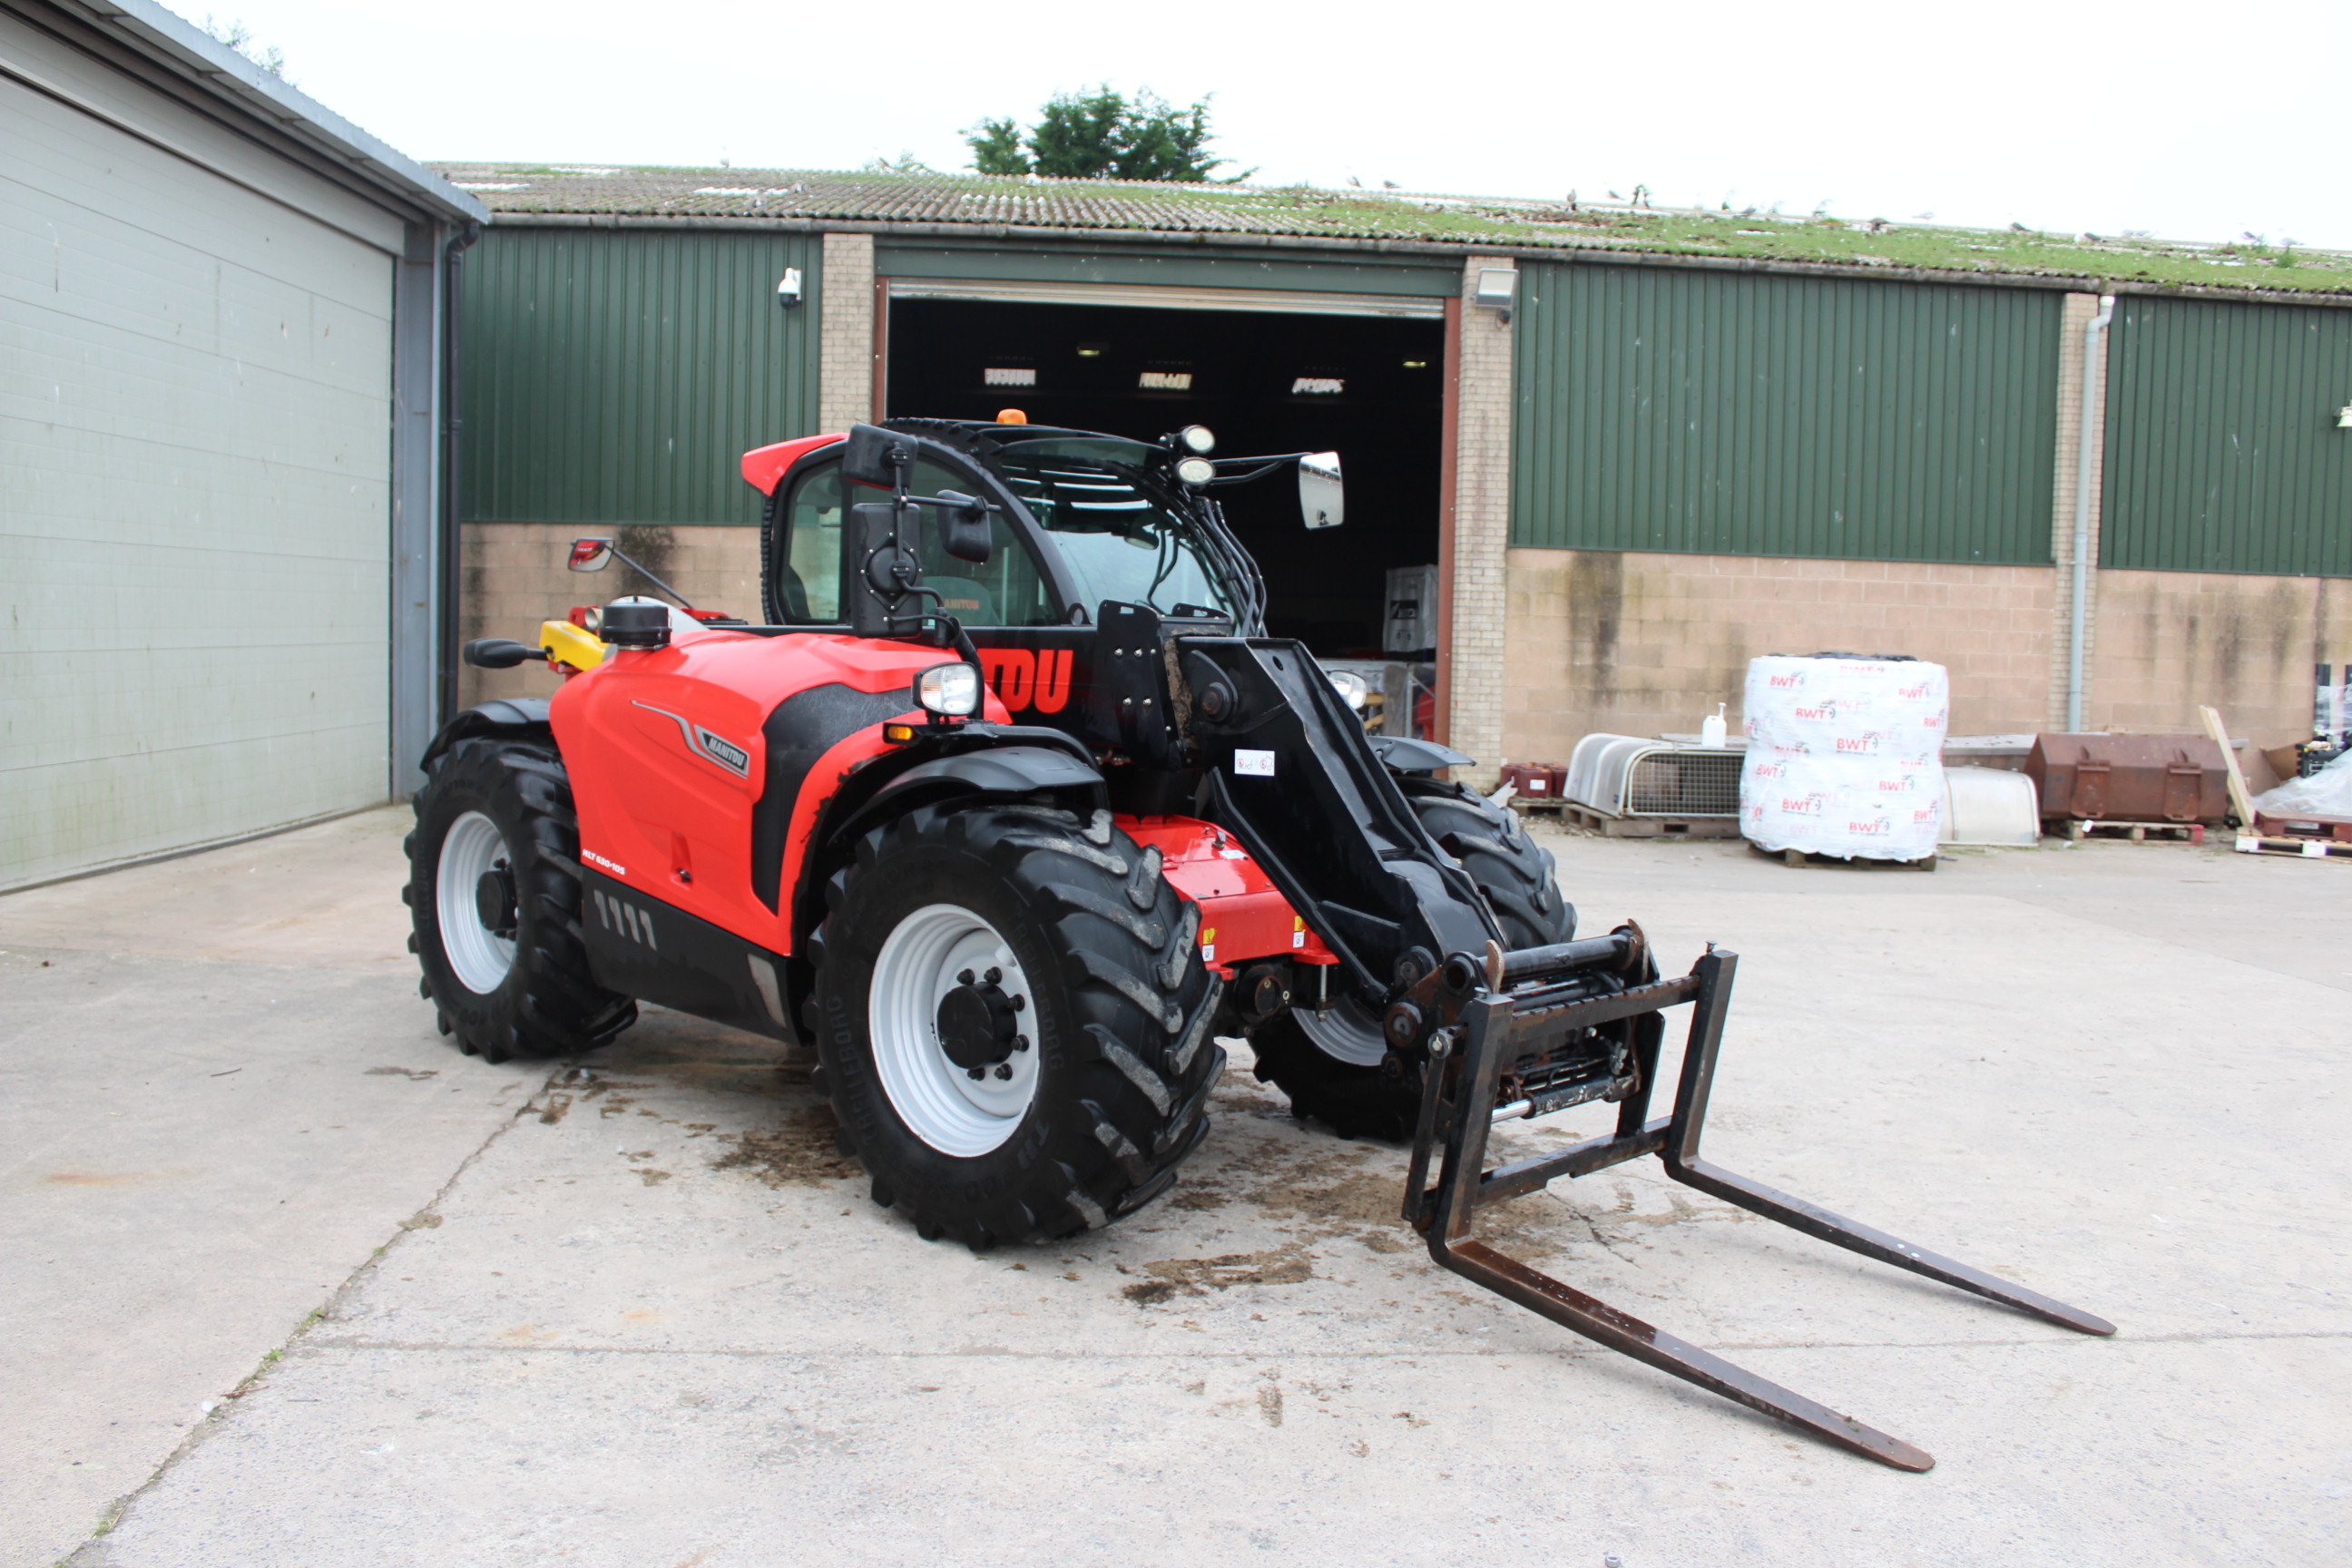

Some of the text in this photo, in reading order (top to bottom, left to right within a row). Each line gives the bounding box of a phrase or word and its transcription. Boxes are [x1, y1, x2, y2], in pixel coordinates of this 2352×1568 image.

[1837, 738, 1869, 751] BWT
[708, 737, 745, 767] MANITOU
[1757, 764, 1779, 778] BWT
[1879, 780, 1906, 791] BWT
[1782, 799, 1811, 812] BWT
[1849, 822, 1880, 833] BWT
[582, 848, 596, 861] MLT
